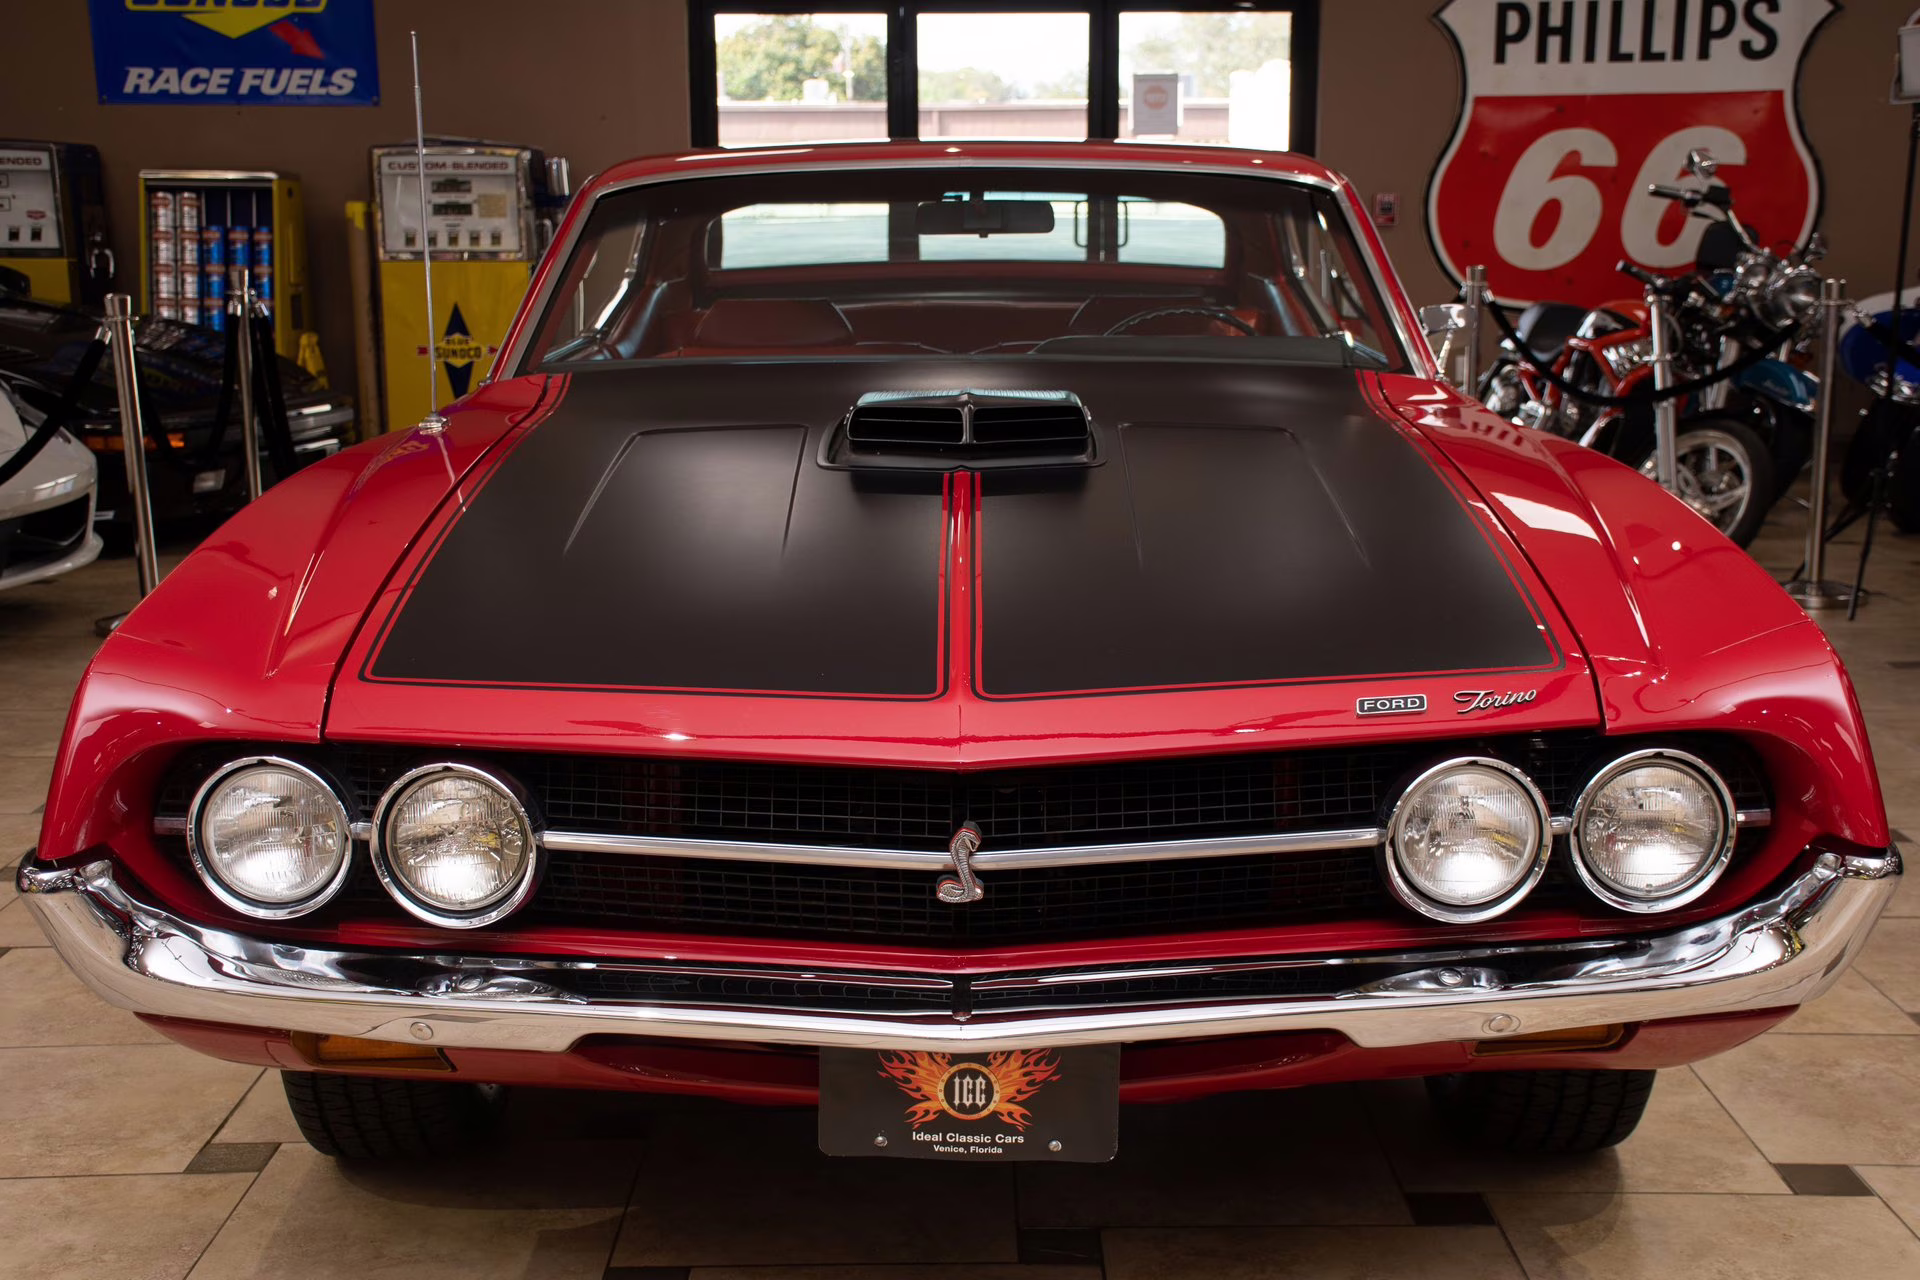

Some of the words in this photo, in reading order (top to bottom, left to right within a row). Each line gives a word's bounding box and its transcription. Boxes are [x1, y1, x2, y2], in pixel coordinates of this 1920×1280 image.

[1494, 0, 1780, 64] PHILLIPS
[123, 67, 234, 95] RACE
[238, 68, 357, 96] FUELS
[1493, 126, 1748, 271] 66
[1363, 698, 1420, 711] FORD
[1453, 689, 1537, 714] Torino
[953, 1073, 987, 1110] ICC
[912, 1131, 943, 1142] Ideal
[946, 1132, 991, 1144] Classic
[995, 1133, 1025, 1144] Cars
[933, 1144, 967, 1155] Venice,
[970, 1145, 1003, 1154] Florida
